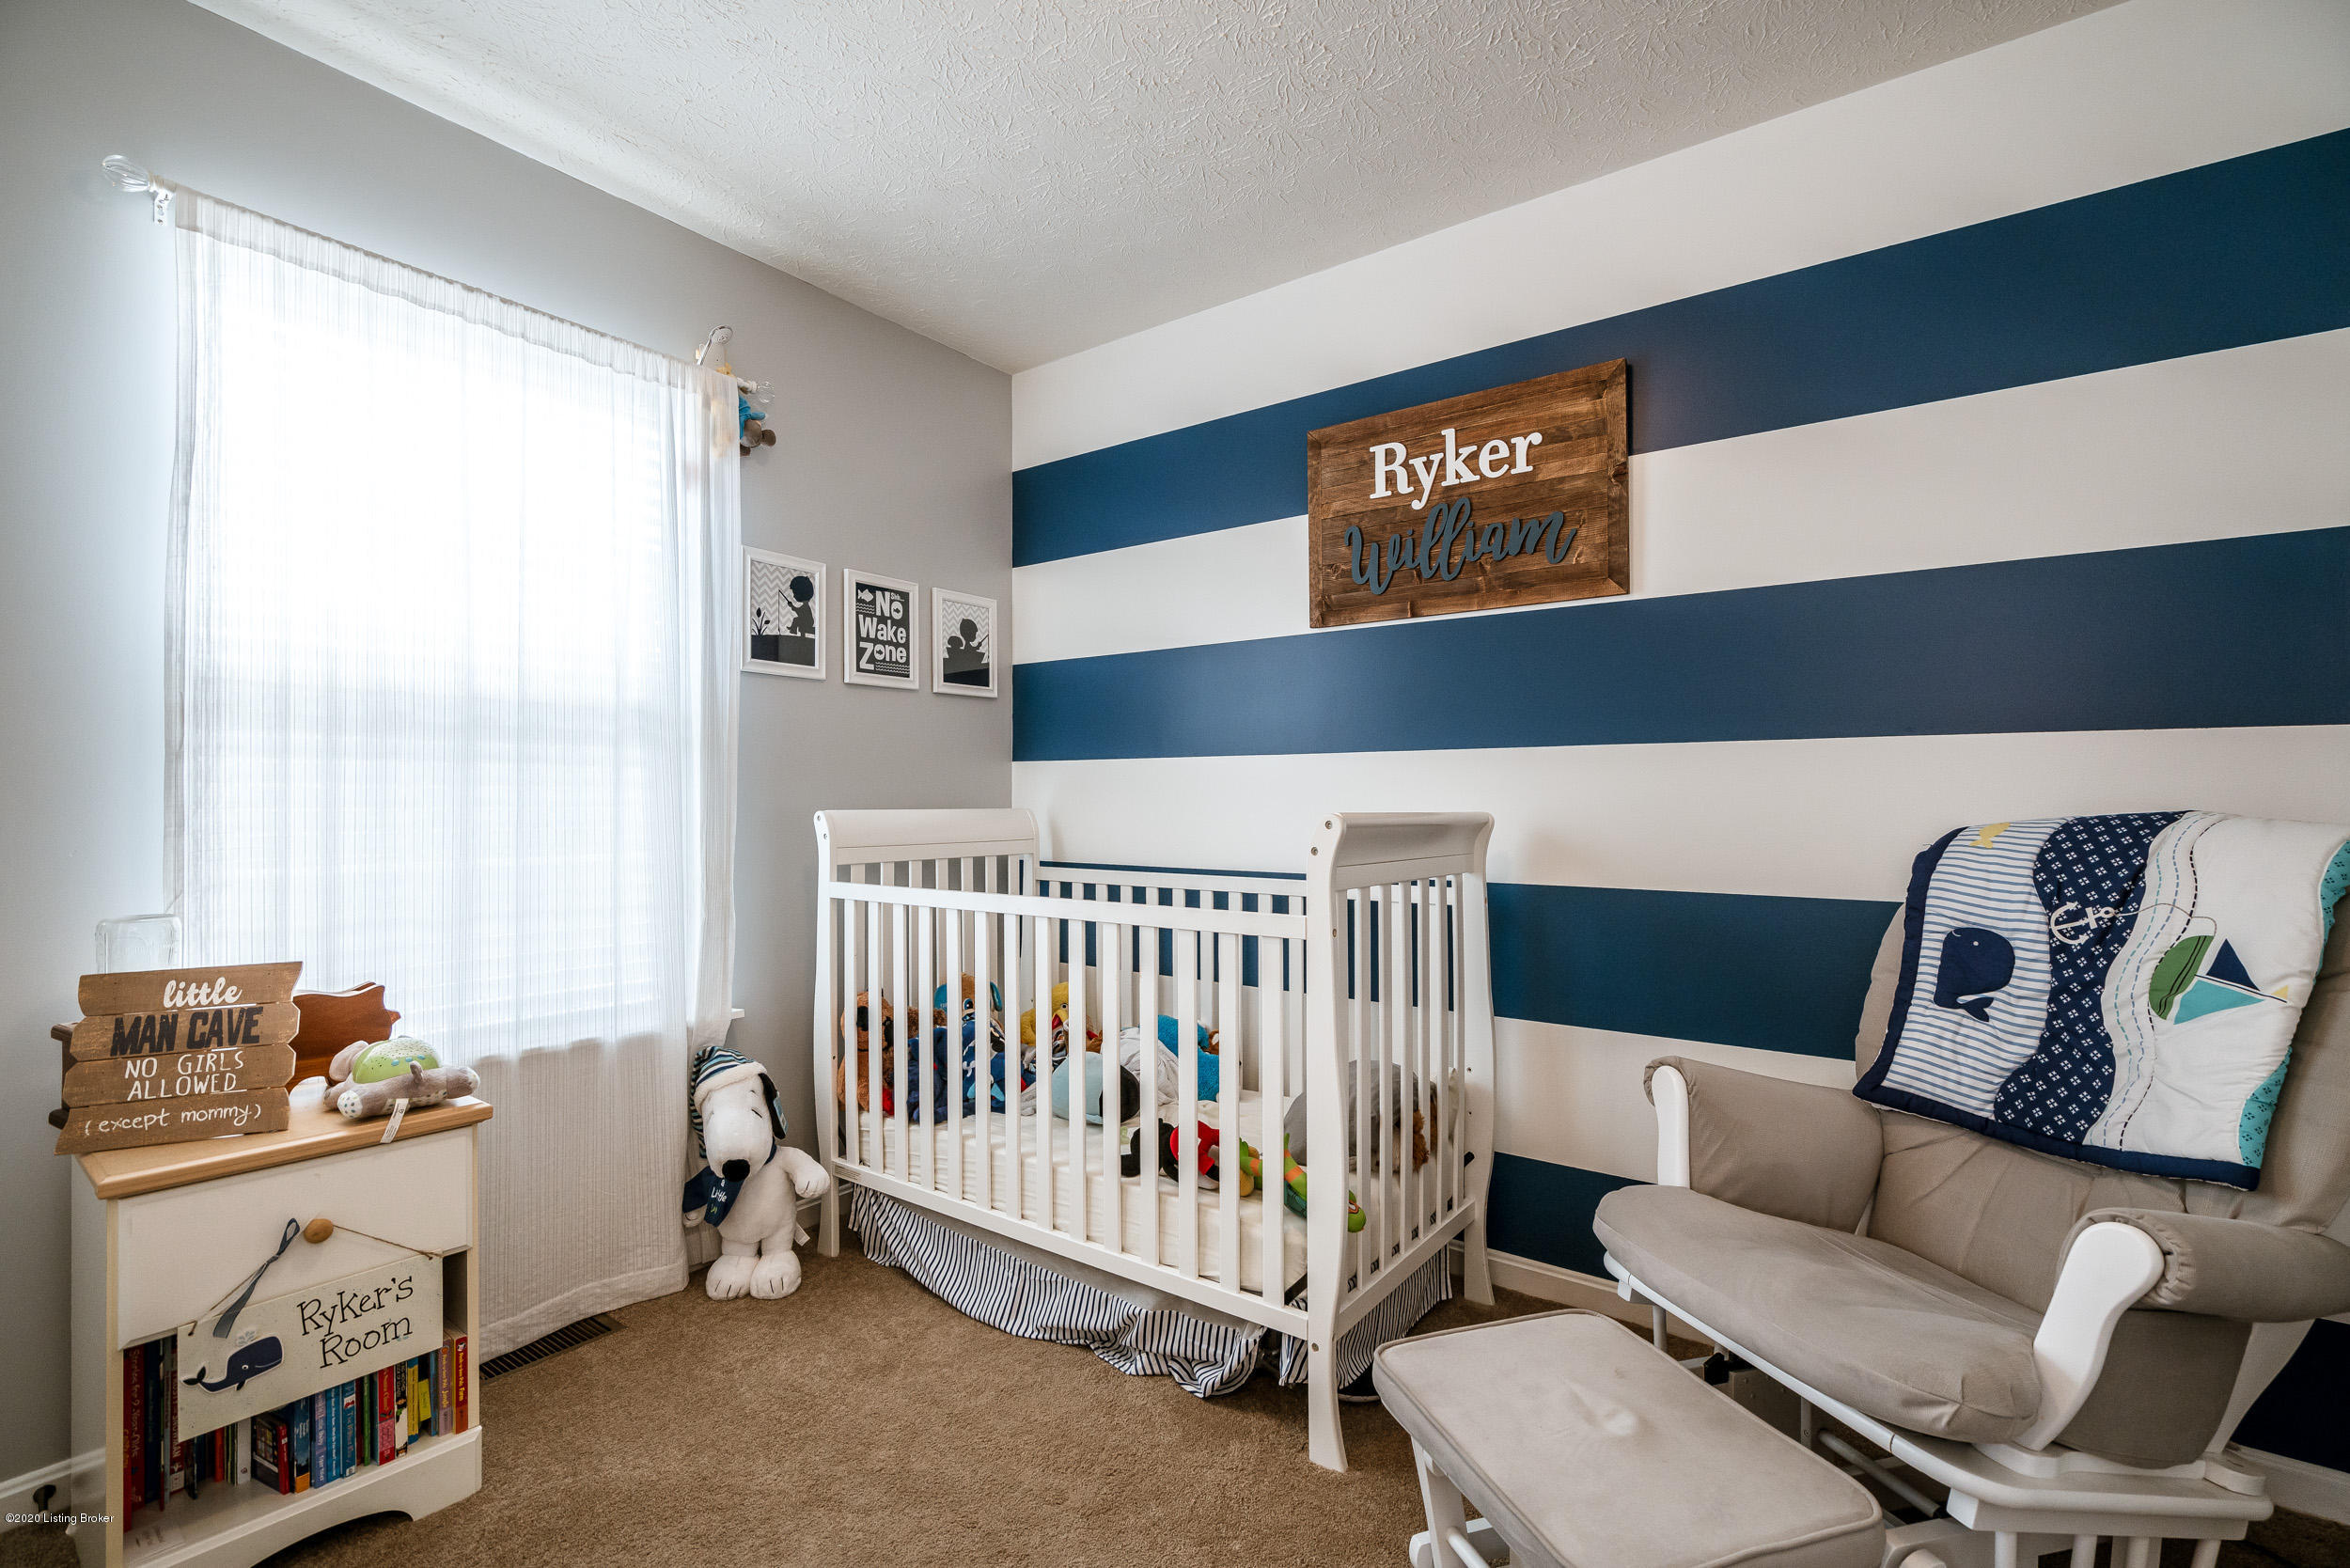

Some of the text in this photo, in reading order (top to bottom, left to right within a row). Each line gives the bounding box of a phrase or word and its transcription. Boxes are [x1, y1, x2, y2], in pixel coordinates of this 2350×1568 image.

[1369, 428, 1543, 510] Ryker
[1344, 497, 1577, 595] William
[875, 590, 903, 620] No
[858, 614, 906, 644] Wake
[859, 641, 906, 670] Zone
[163, 977, 243, 1009] little
[110, 1006, 264, 1058] MAN CAVE
[124, 1050, 244, 1079] NO GIRLS
[127, 1073, 237, 1101] ALLOWED
[297, 1276, 414, 1337] Ryker's
[320, 1317, 413, 1369] Room
